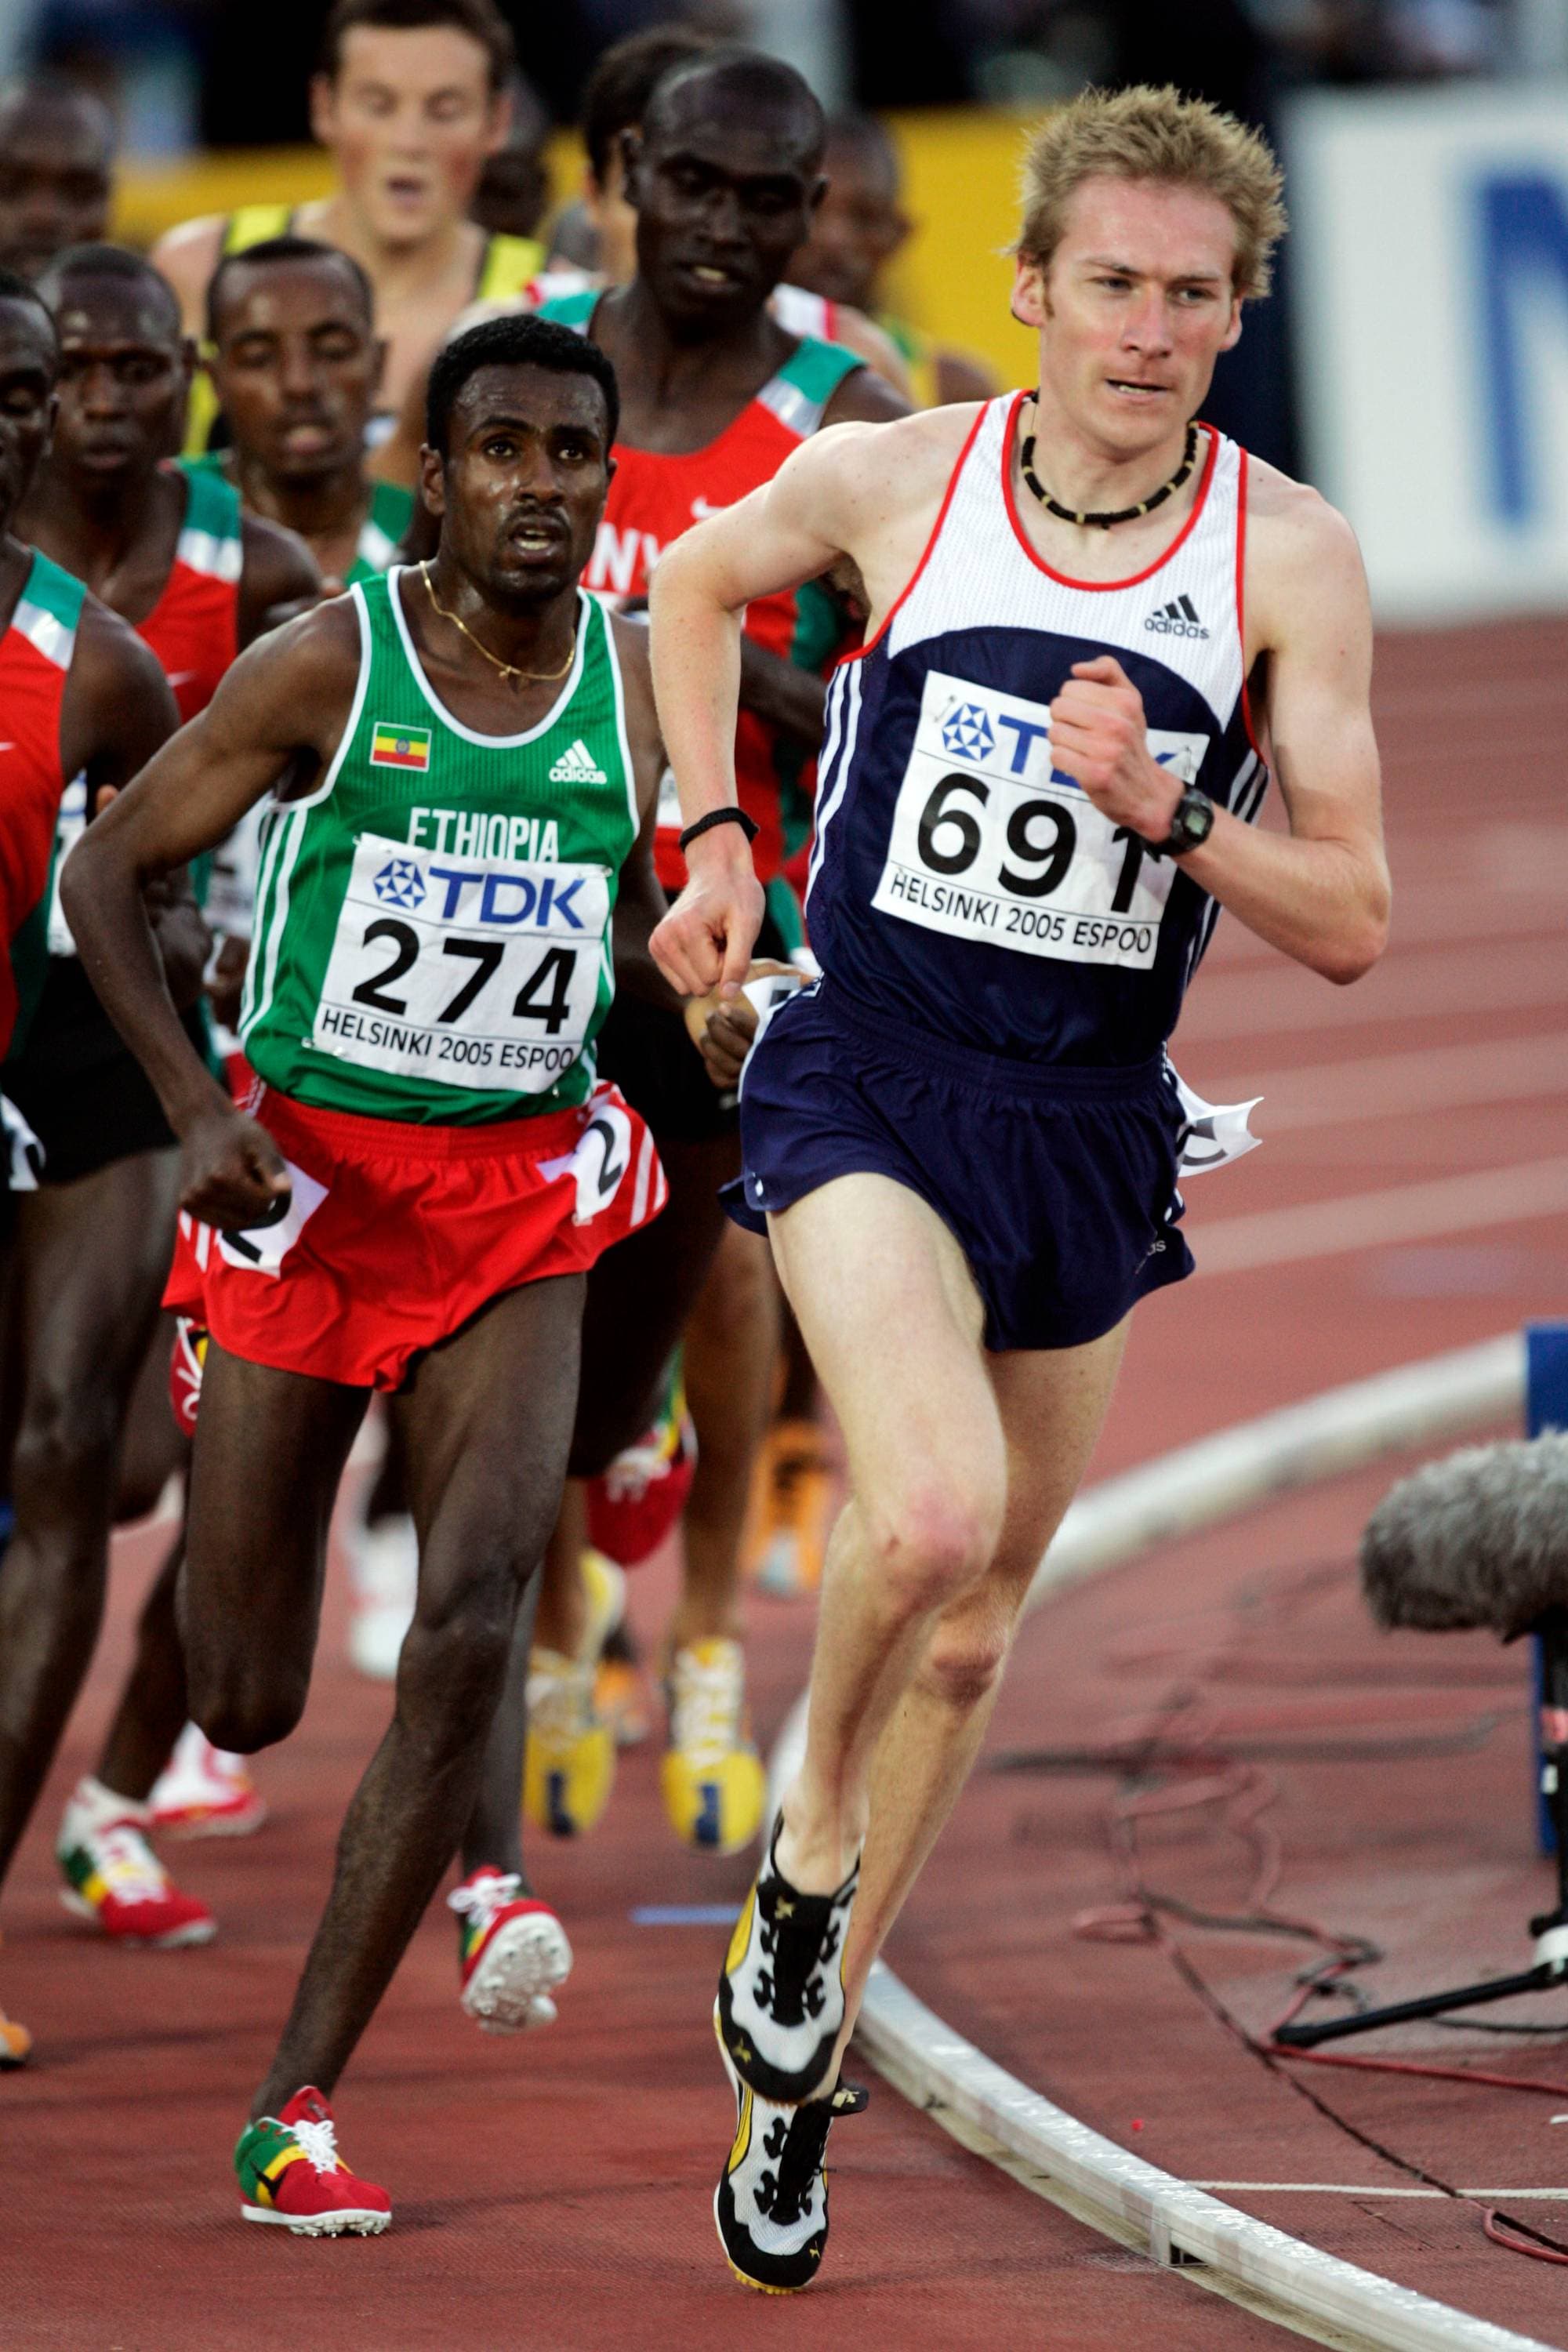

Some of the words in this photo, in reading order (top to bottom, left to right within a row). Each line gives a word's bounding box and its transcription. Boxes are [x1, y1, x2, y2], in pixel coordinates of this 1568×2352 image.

[1145, 617, 1210, 640] adidas
[549, 765, 608, 785] adidas
[407, 807, 559, 863] ETHIOPIA
[917, 772, 1145, 914] 691
[429, 866, 586, 930] TDK
[891, 873, 1000, 928] HELSINKI
[1005, 907, 1066, 942] 2005
[1072, 920, 1152, 953] ESPOO
[351, 918, 578, 1034] 274
[321, 1008, 432, 1057] HELSINKI
[438, 1036, 493, 1067] 2005
[499, 1044, 574, 1072] ESPOO
